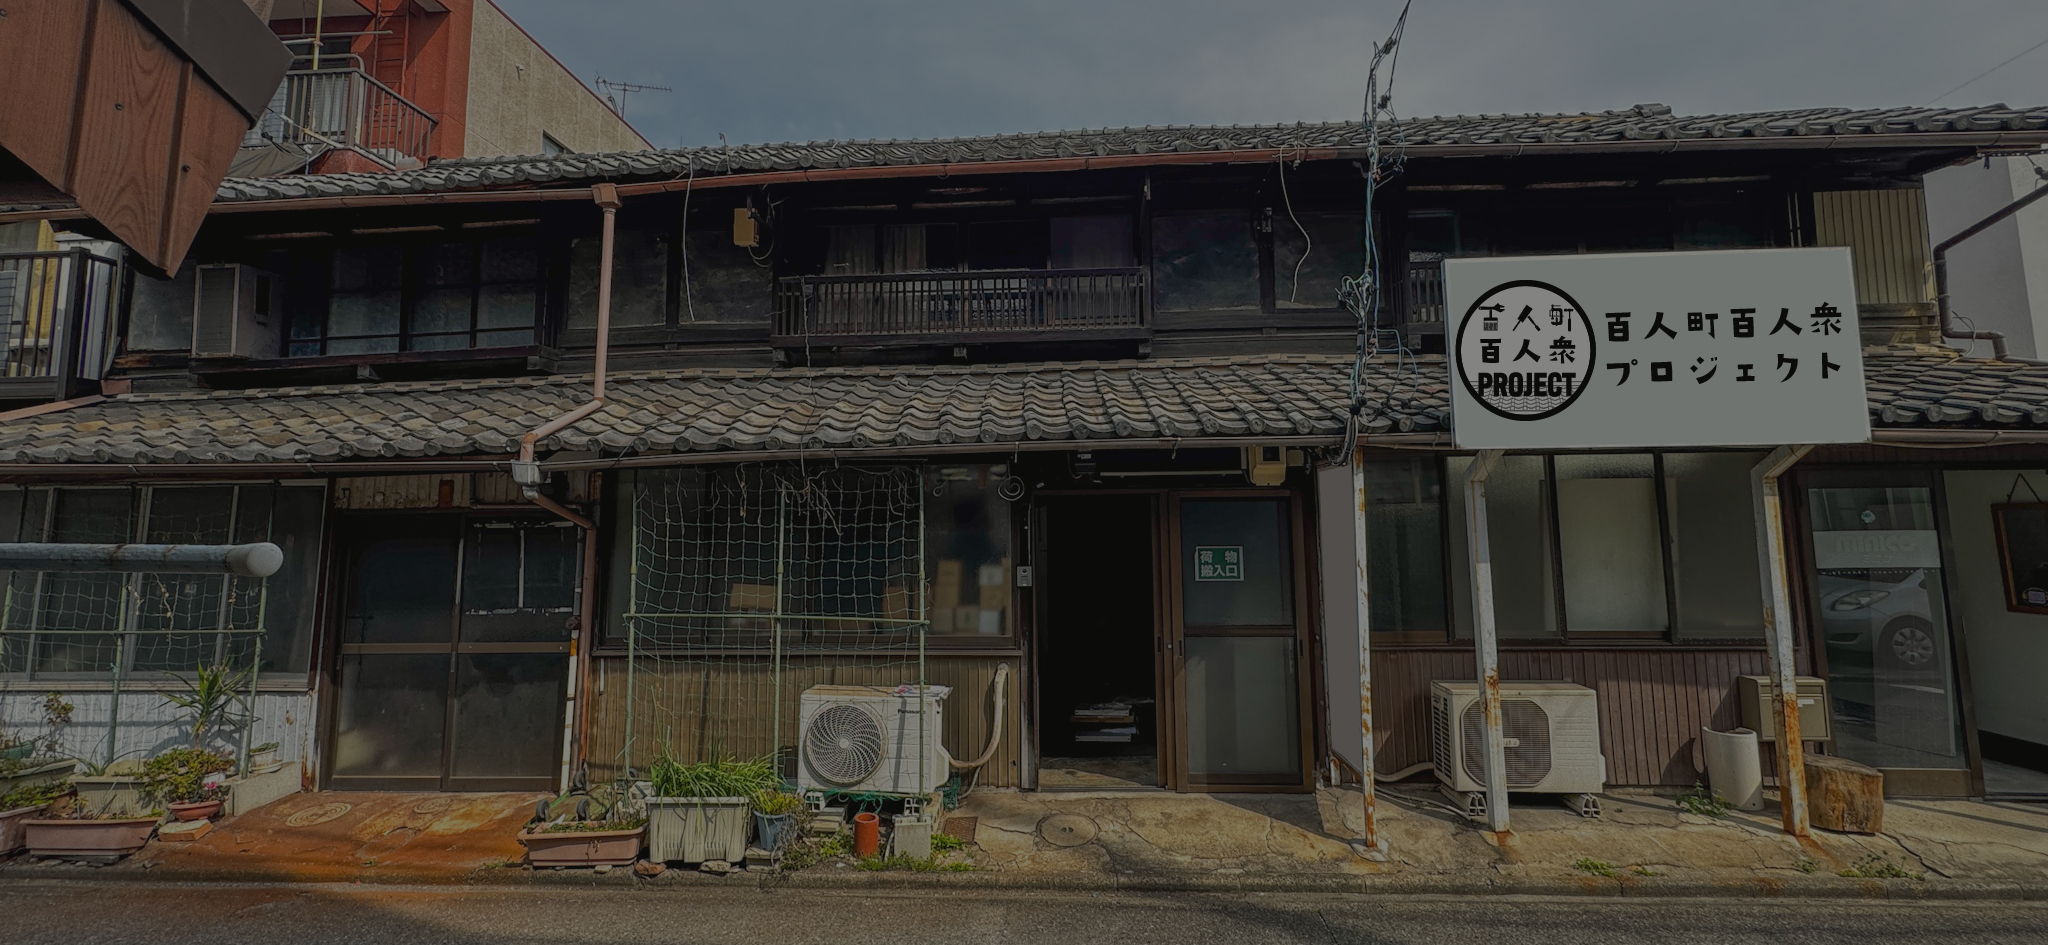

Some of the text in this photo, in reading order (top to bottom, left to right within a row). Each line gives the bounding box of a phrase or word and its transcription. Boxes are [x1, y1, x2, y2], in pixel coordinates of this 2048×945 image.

[1605, 301, 1842, 342] 百人町百人衆
[1480, 335, 1576, 364] 百人衆
[1606, 352, 1841, 387] プロジェクト
[1478, 372, 1576, 397] PROJECT
[1200, 564, 1238, 577] 搬入口
